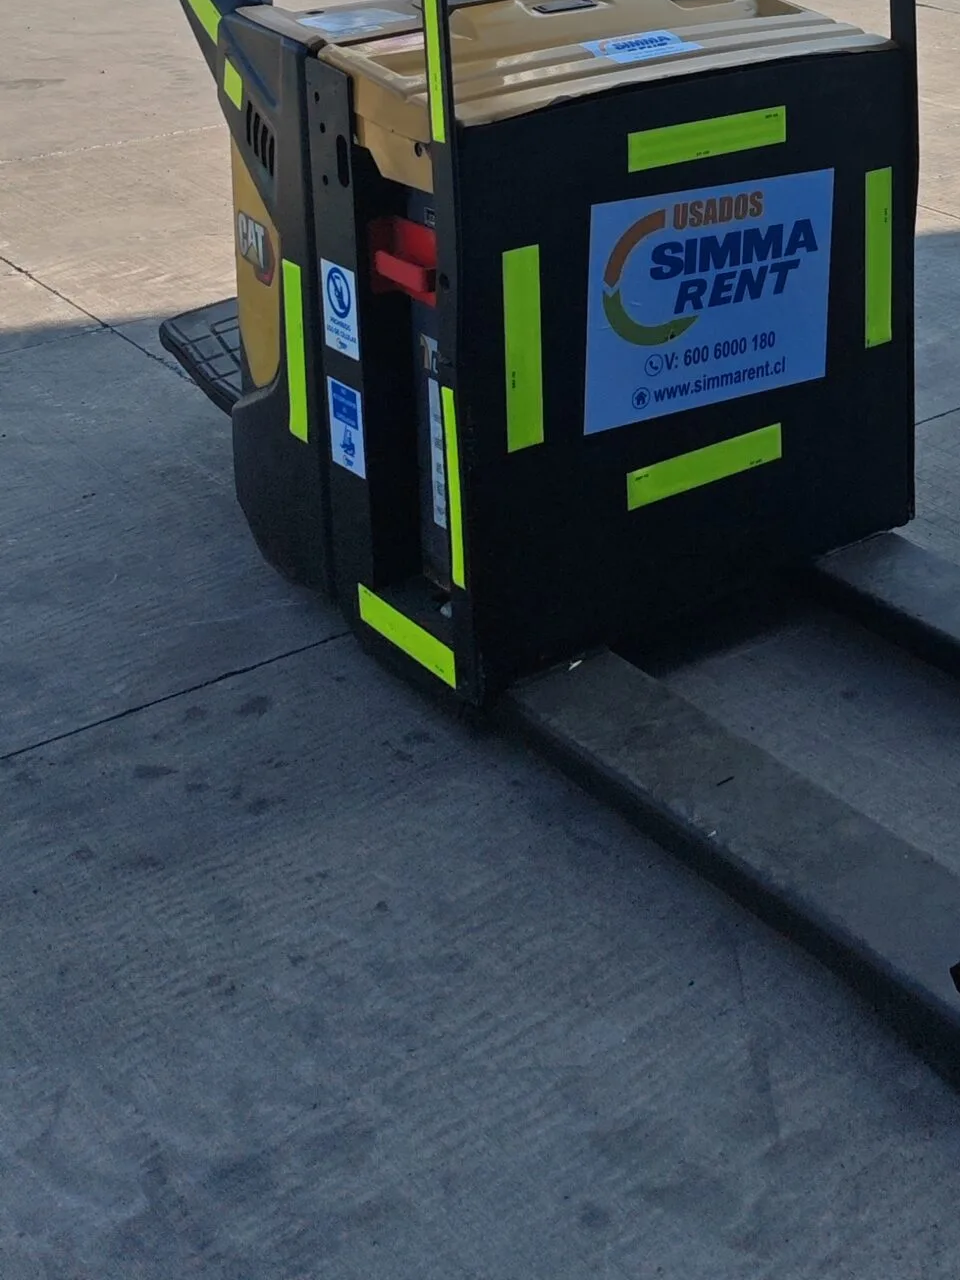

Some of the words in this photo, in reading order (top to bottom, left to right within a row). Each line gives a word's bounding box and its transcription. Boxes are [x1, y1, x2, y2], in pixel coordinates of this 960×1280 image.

[673, 191, 763, 230] USADOS
[239, 212, 265, 269] CAT
[650, 219, 818, 280] SIMMA
[673, 258, 801, 314] RENT
[664, 352, 679, 370] V:
[683, 345, 709, 366] 600
[713, 337, 747, 359] 6000
[751, 331, 776, 351] 180
[653, 356, 786, 402] www.simmarent.cl
